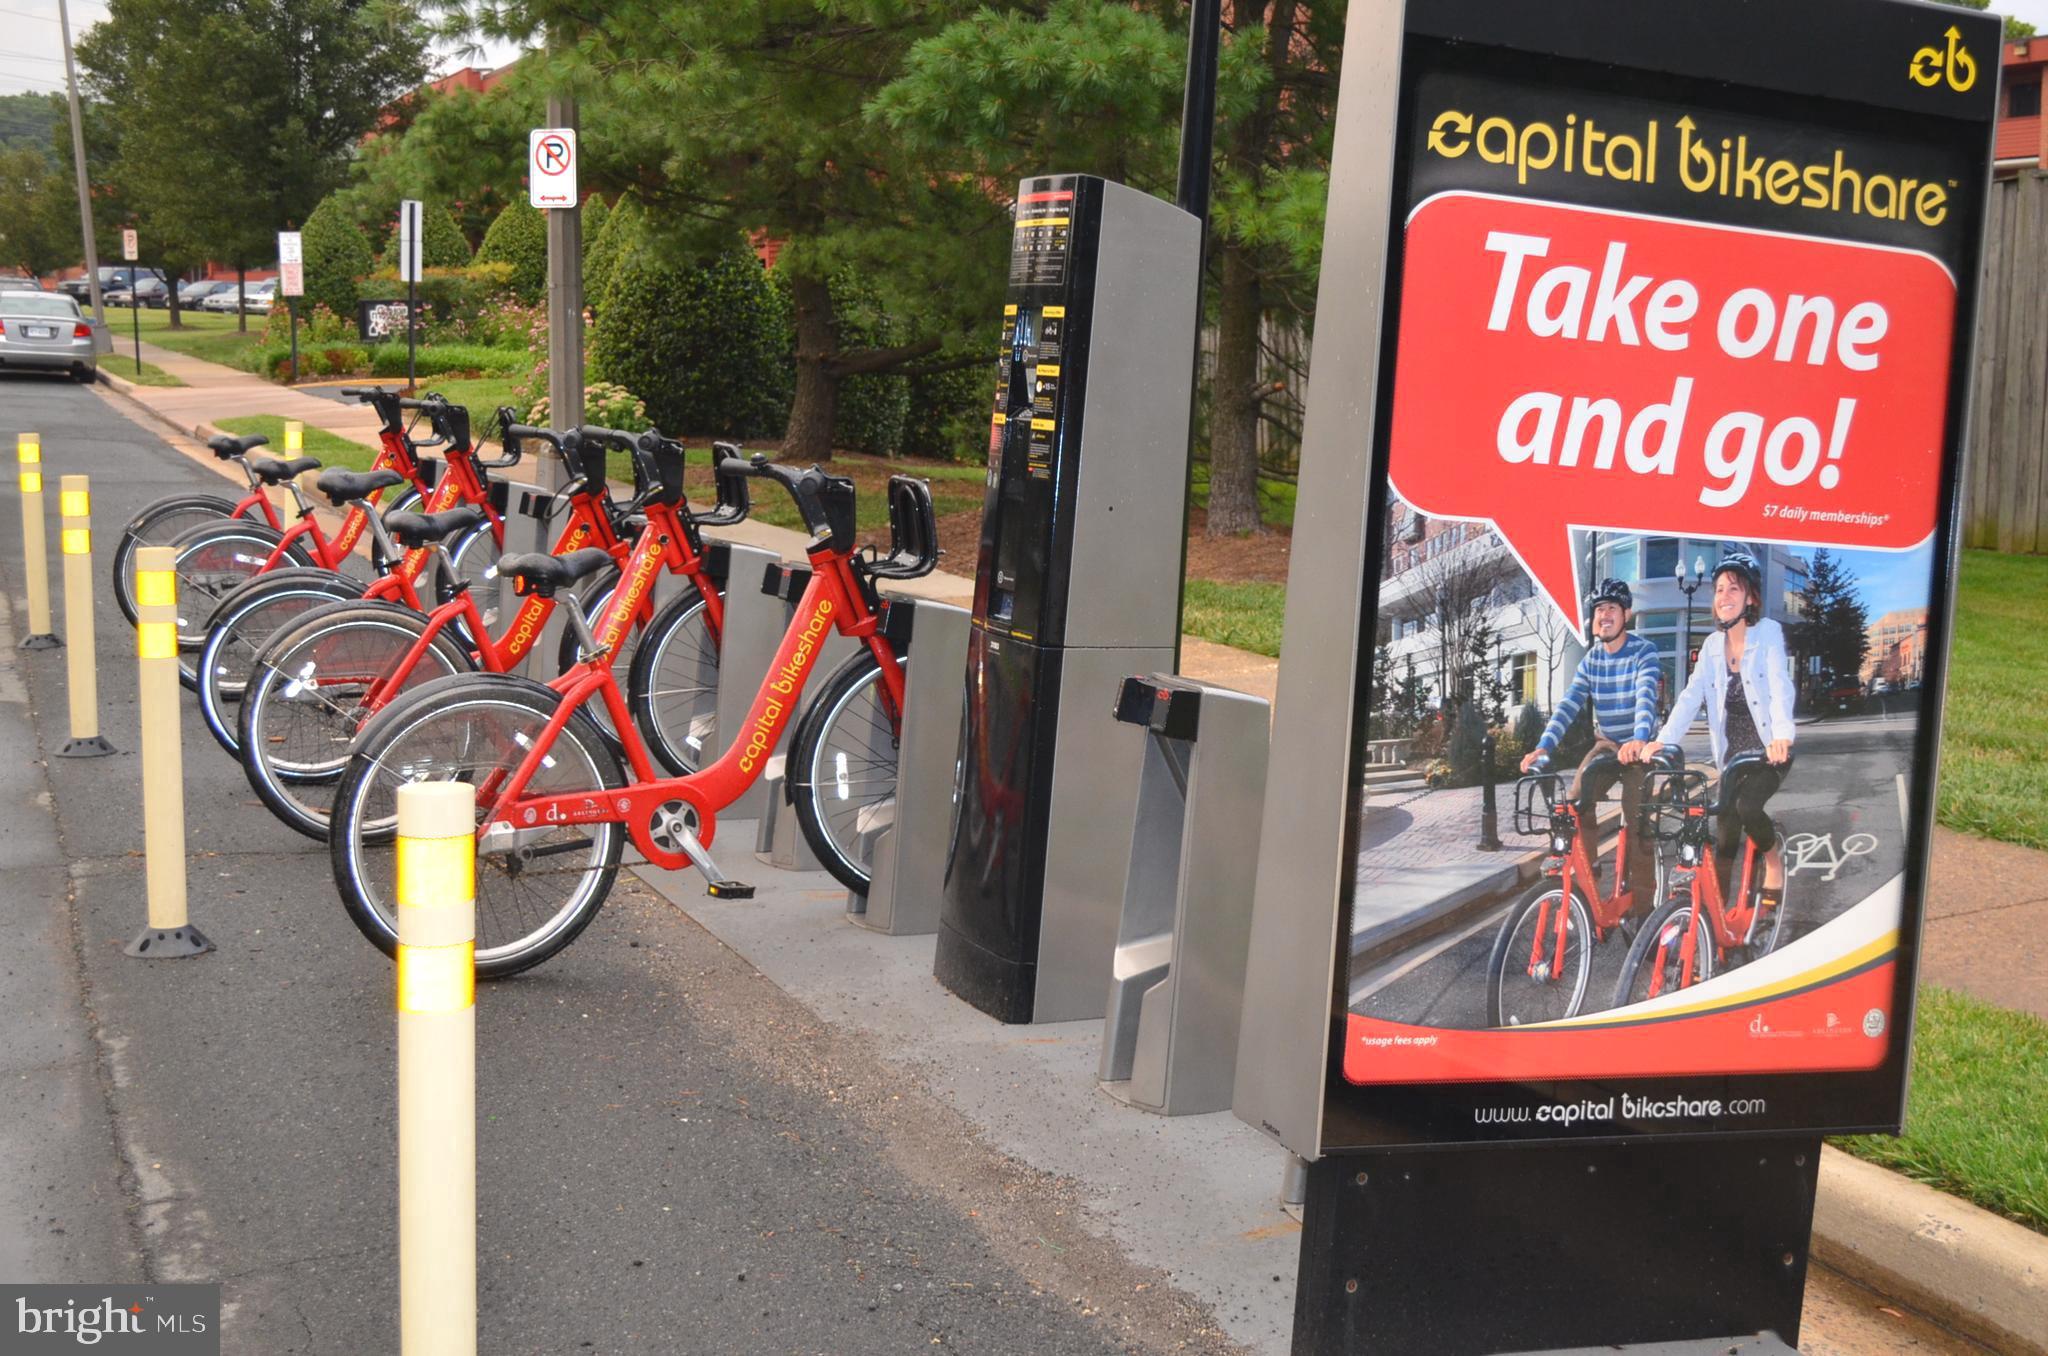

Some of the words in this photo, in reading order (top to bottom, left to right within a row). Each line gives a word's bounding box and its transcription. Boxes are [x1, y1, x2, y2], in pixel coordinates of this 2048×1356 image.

[1427, 110, 1658, 184] capital
[1484, 231, 1699, 352] Take
[1716, 288, 1889, 371] one
[1497, 376, 1695, 476] and
[1699, 398, 1858, 508] go!
[1763, 504, 1779, 518] $7
[1779, 505, 1809, 522] daily
[612, 543, 661, 622] bikeshare
[509, 598, 545, 655] capital
[739, 696, 783, 774] capital
[770, 599, 833, 694] bikeshare
[1394, 1035, 1413, 1045] fees
[1413, 1035, 1438, 1046] apply
